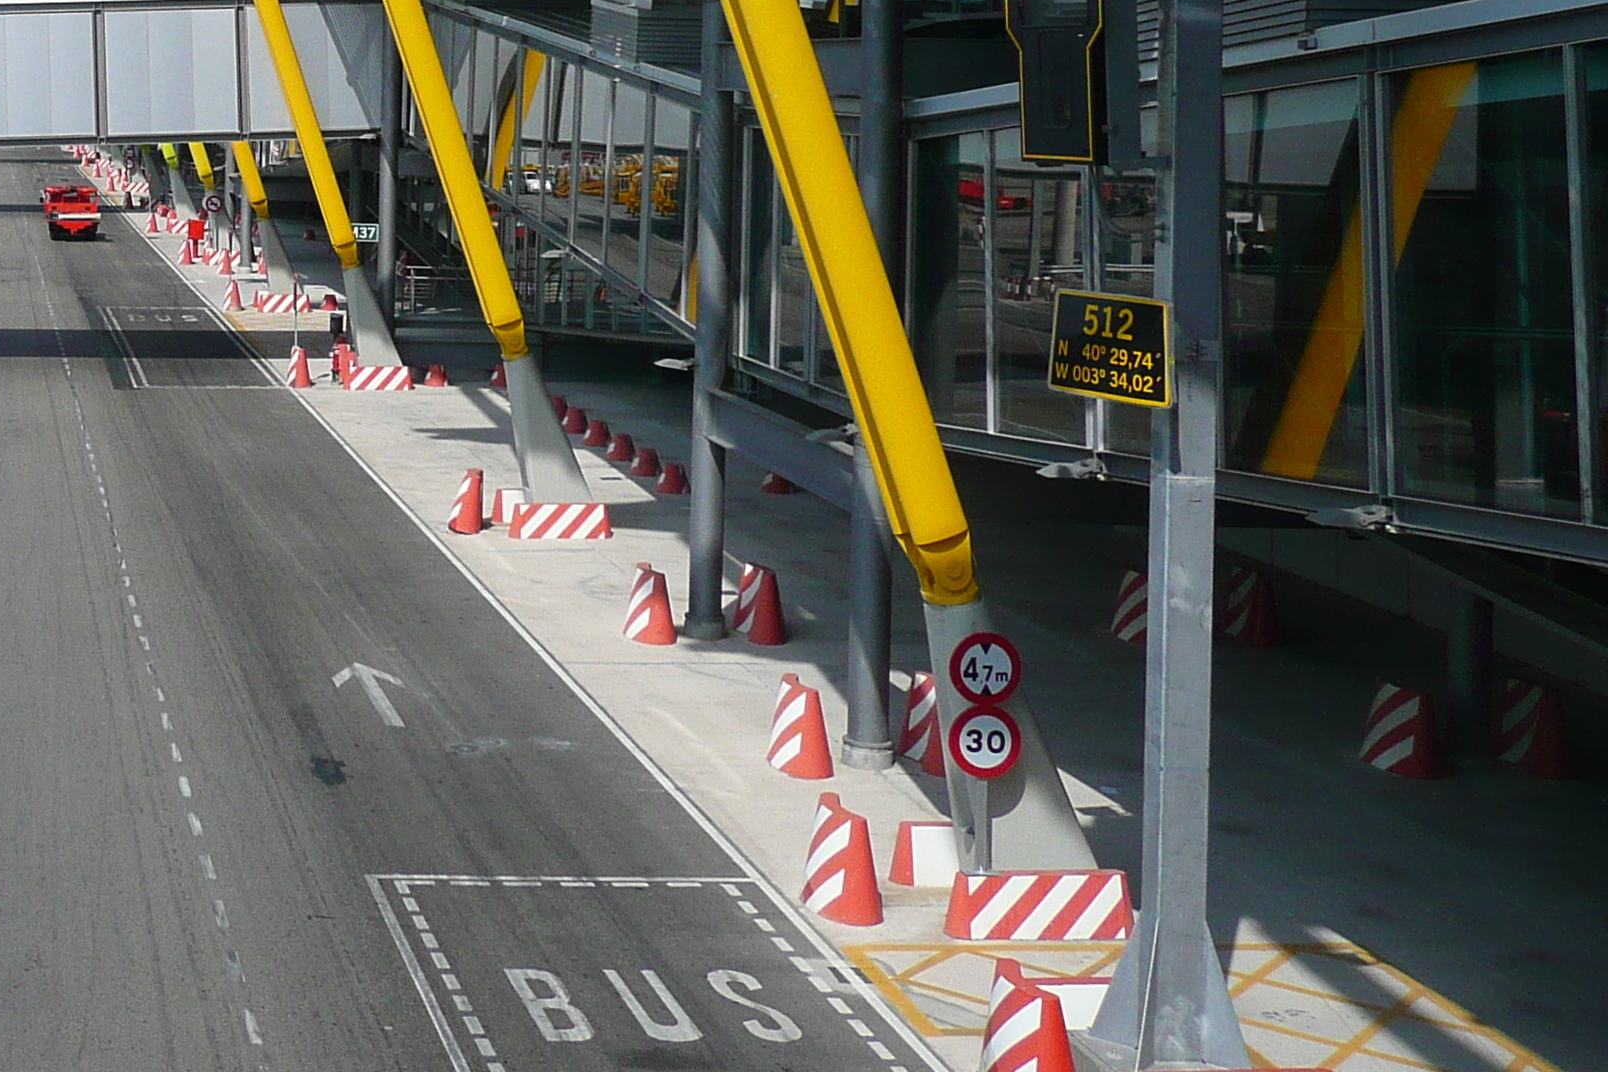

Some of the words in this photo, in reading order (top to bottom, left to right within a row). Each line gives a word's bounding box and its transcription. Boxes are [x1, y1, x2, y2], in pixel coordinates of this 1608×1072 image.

[1083, 304, 1134, 341] 512
[1058, 340, 1068, 357] N
[1055, 362, 1069, 379] W
[965, 729, 1006, 754] 30
[503, 968, 803, 1042] BUS
